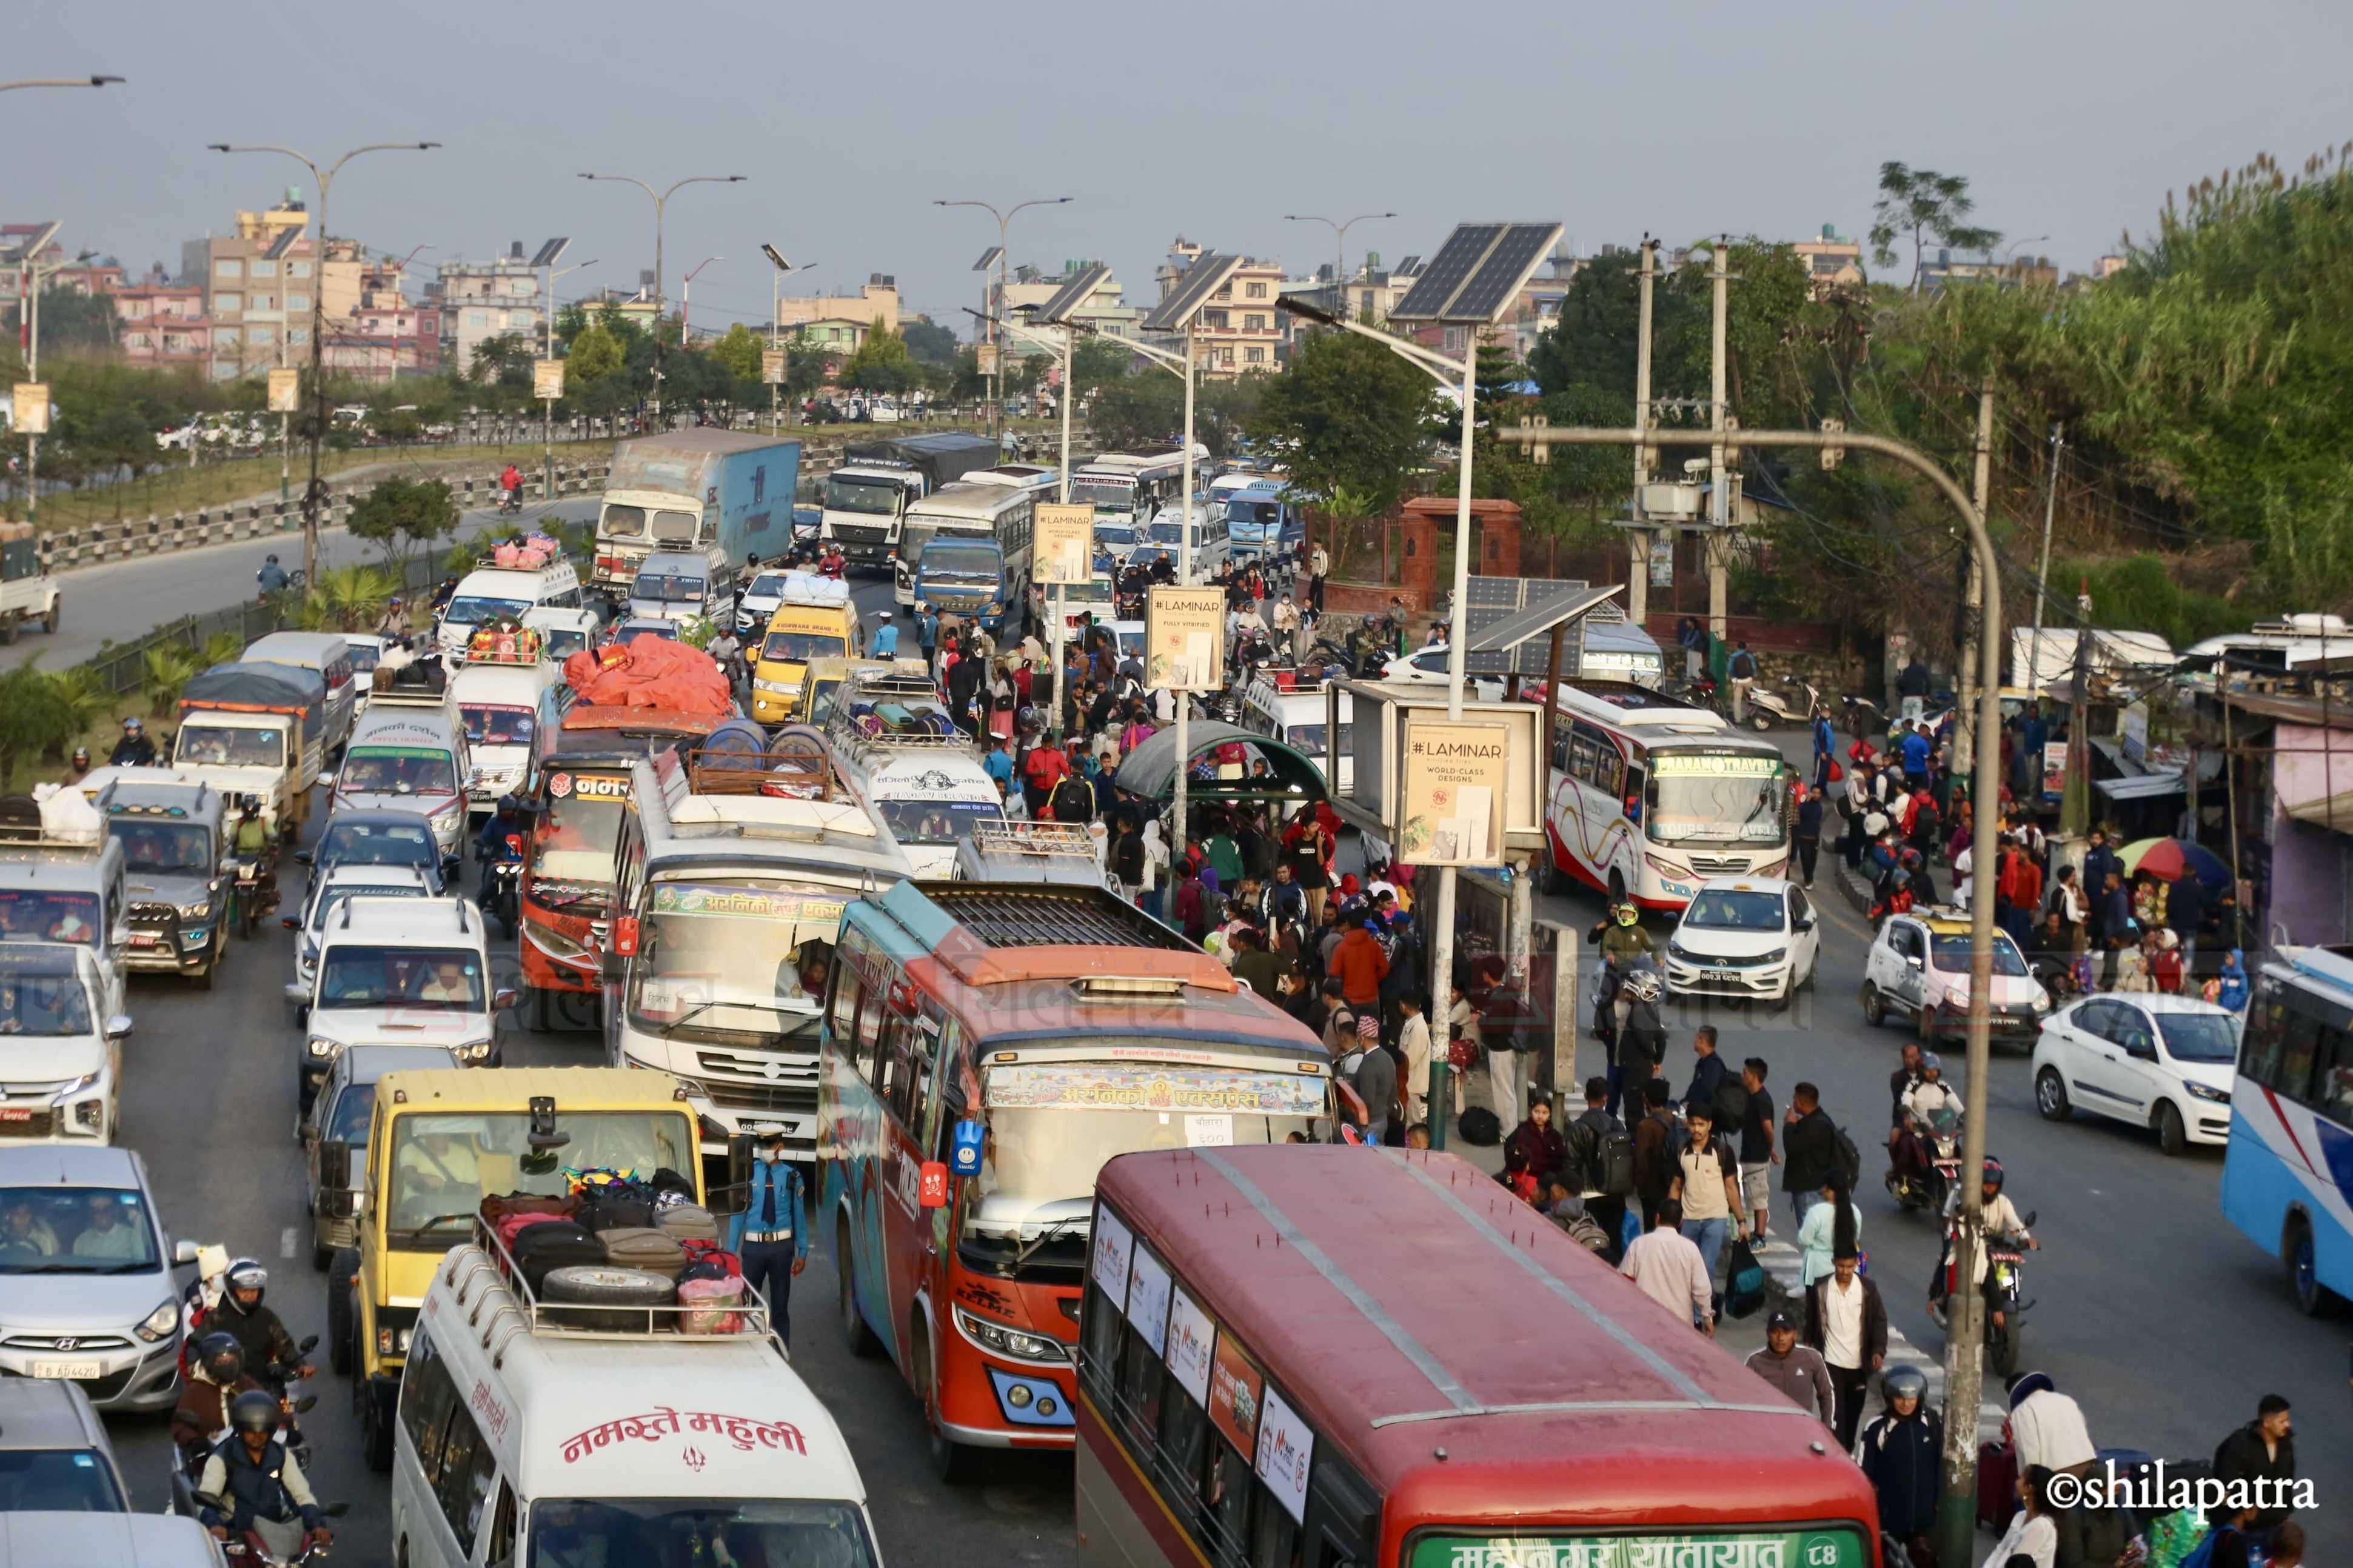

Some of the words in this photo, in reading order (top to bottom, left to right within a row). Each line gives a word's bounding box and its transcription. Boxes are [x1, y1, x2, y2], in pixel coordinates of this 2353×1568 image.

[1154, 600, 1219, 612] #LAMINAR
[1411, 741, 1502, 759] #LAMINAR
[1427, 767, 1485, 776] WORLD-CLASS
[891, 792, 936, 800] YADAV
[939, 793, 982, 801] BRAND
[704, 894, 773, 915] अरनिको
[1058, 1082, 1148, 1105] अरनिको
[1174, 1087, 1262, 1110] एक्सप्रेस
[1199, 1133, 1224, 1145] ६००
[559, 1405, 680, 1464] नमस्ते
[684, 1411, 808, 1457] महुली
[1630, 1539, 1786, 1568] यातायात
